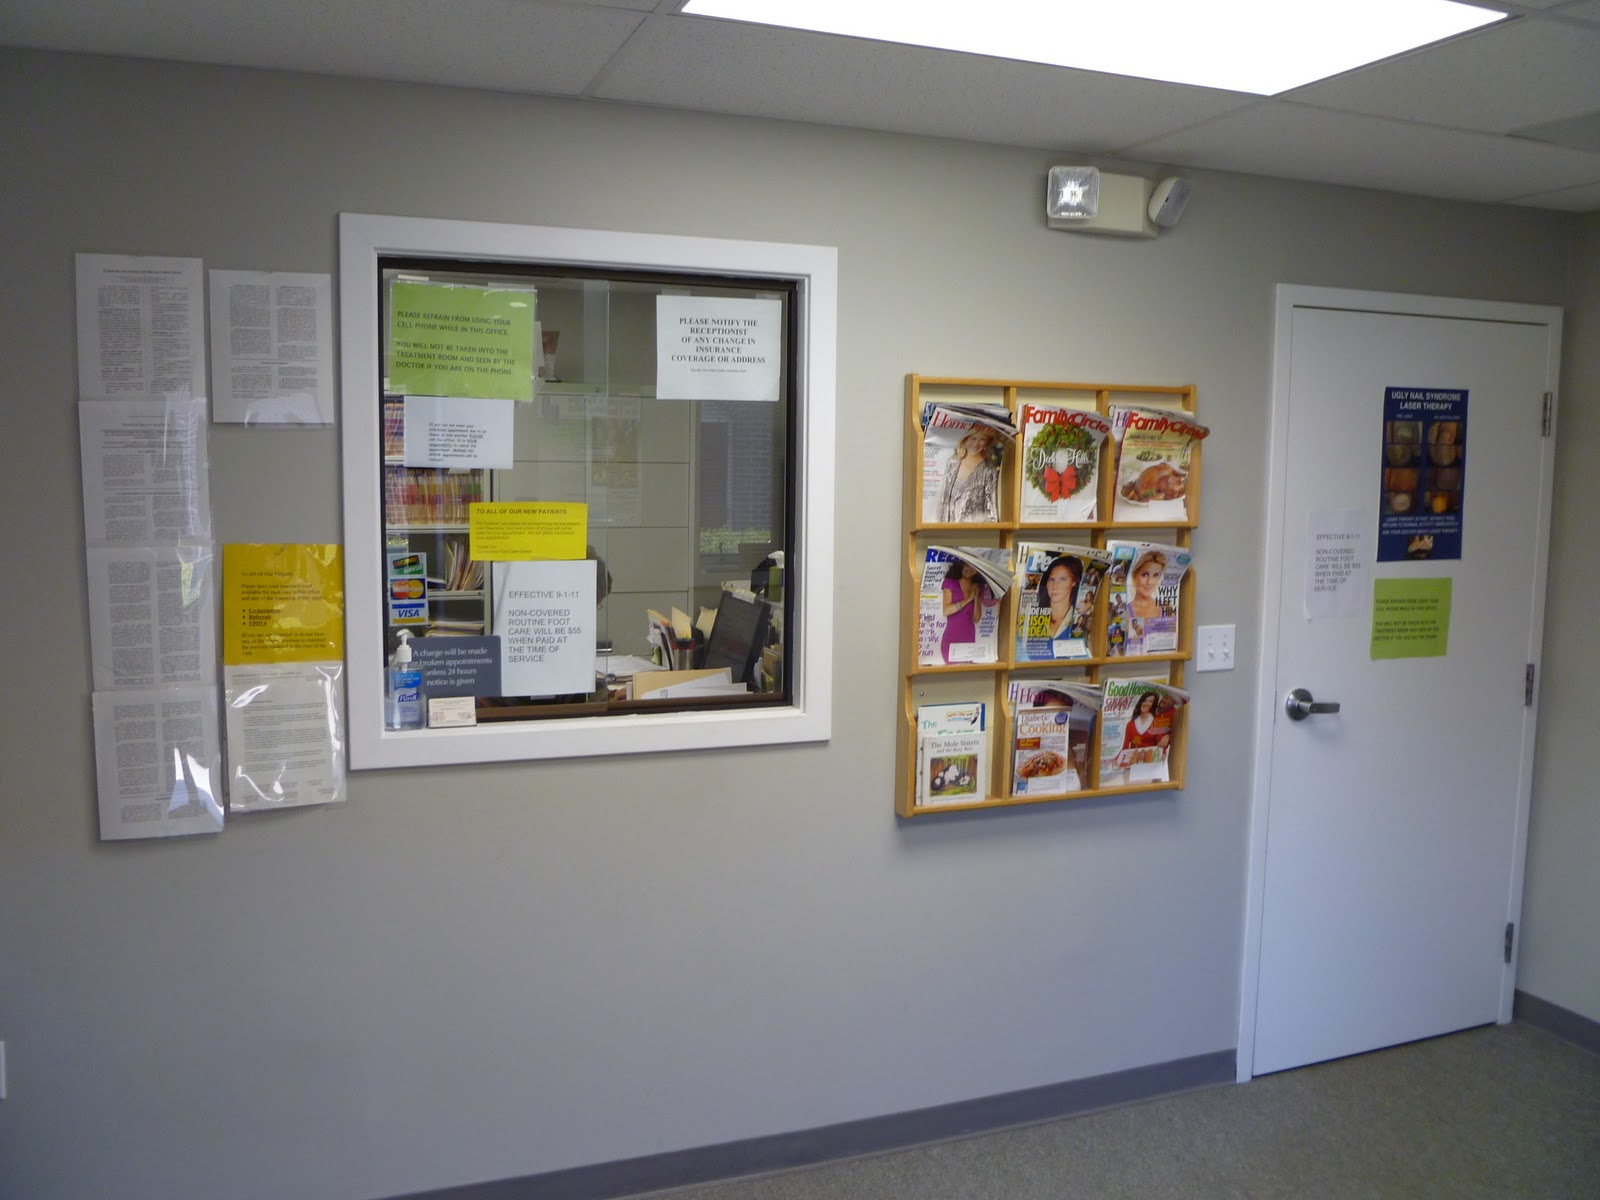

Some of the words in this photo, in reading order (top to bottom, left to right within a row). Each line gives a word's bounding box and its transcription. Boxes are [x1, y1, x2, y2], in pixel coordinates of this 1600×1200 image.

[397, 311, 421, 319] PLEASE
[423, 313, 450, 321] REFRAIN
[451, 314, 470, 322] FROM
[472, 316, 491, 324] USING
[493, 318, 511, 326] YOUR
[711, 319, 741, 327] NOTIFY
[439, 324, 458, 332] WHILE
[690, 327, 748, 336] RECEPTIONIST
[456, 345, 477, 353] TAKEN
[696, 346, 741, 354] INSURANCE
[396, 351, 436, 360] TREATMENT
[438, 353, 458, 361] ROOM
[460, 355, 475, 363] AND
[671, 355, 716, 363] COVERAGE
[395, 361, 425, 369] DOCTOR
[491, 367, 512, 375] PHONE
[1391, 391, 1409, 399] UGLY
[1409, 391, 1424, 400] NAIL
[1425, 392, 1461, 401] SYNDROME
[1400, 401, 1422, 410] LASER
[1423, 402, 1453, 411] THERAPY
[508, 591, 554, 599] EFFECTIVE
[556, 591, 580, 599] 9-1-11
[1158, 586, 1178, 596] WHY
[1159, 596, 1178, 606] LEFT
[398, 609, 420, 618] VISA
[508, 608, 570, 617] NON-COVERED
[1162, 607, 1177, 617] HIM
[508, 618, 546, 626] ROUTINE
[547, 618, 571, 626] FOOT
[508, 627, 531, 636] CARE
[533, 627, 552, 635] WILL
[554, 627, 565, 635] BE
[568, 626, 582, 635] $55
[508, 636, 533, 645] WHEN
[535, 636, 555, 644] PAID
[556, 636, 568, 644] AT
[420, 650, 443, 658] charge
[468, 647, 488, 655] made
[548, 645, 560, 653] OF
[419, 659, 445, 667] broken
[445, 657, 492, 667] appointments
[508, 654, 545, 663] SERVICE
[427, 678, 448, 686] notice
[456, 678, 475, 687] given
[921, 720, 938, 730] The
[1020, 722, 1066, 735] Cooking
